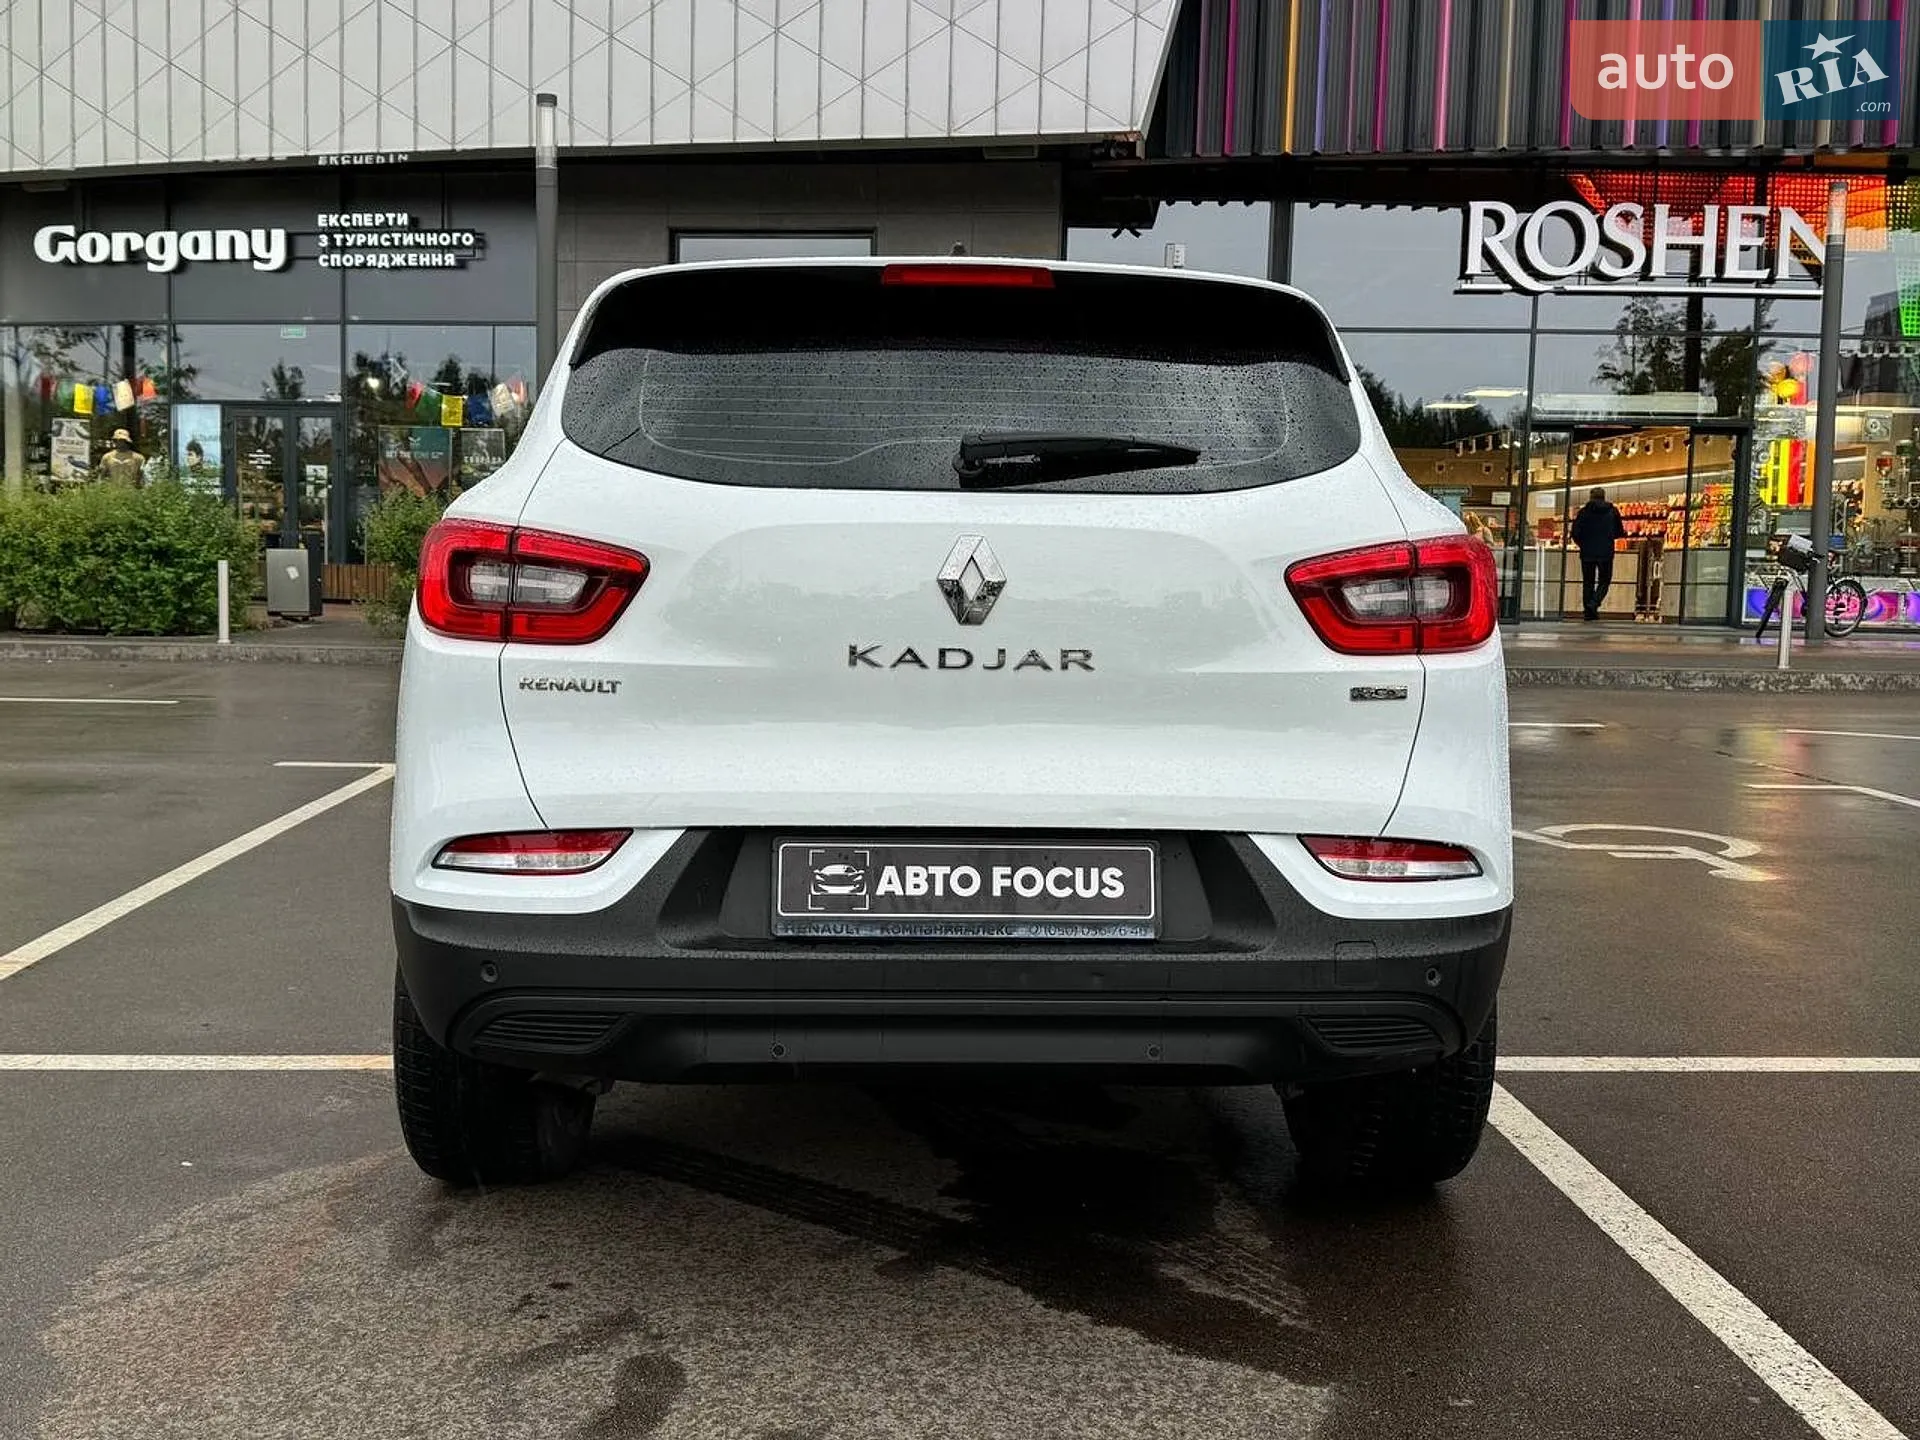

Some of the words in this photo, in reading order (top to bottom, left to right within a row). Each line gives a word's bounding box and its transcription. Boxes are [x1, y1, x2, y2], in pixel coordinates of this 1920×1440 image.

[317, 212, 409, 228] ЕКСПЕРТИ
[34, 225, 286, 273] Gorgany
[333, 232, 475, 247] ТУРИСТИЧНОГО
[1465, 199, 1826, 292] ROSHEN
[318, 252, 456, 269] СПОРЯДЖЕННЯ
[848, 644, 1096, 671] KADJAR
[519, 677, 622, 694] RENAULT
[875, 864, 981, 898] АВТО
[992, 866, 1125, 899] FOCUS
